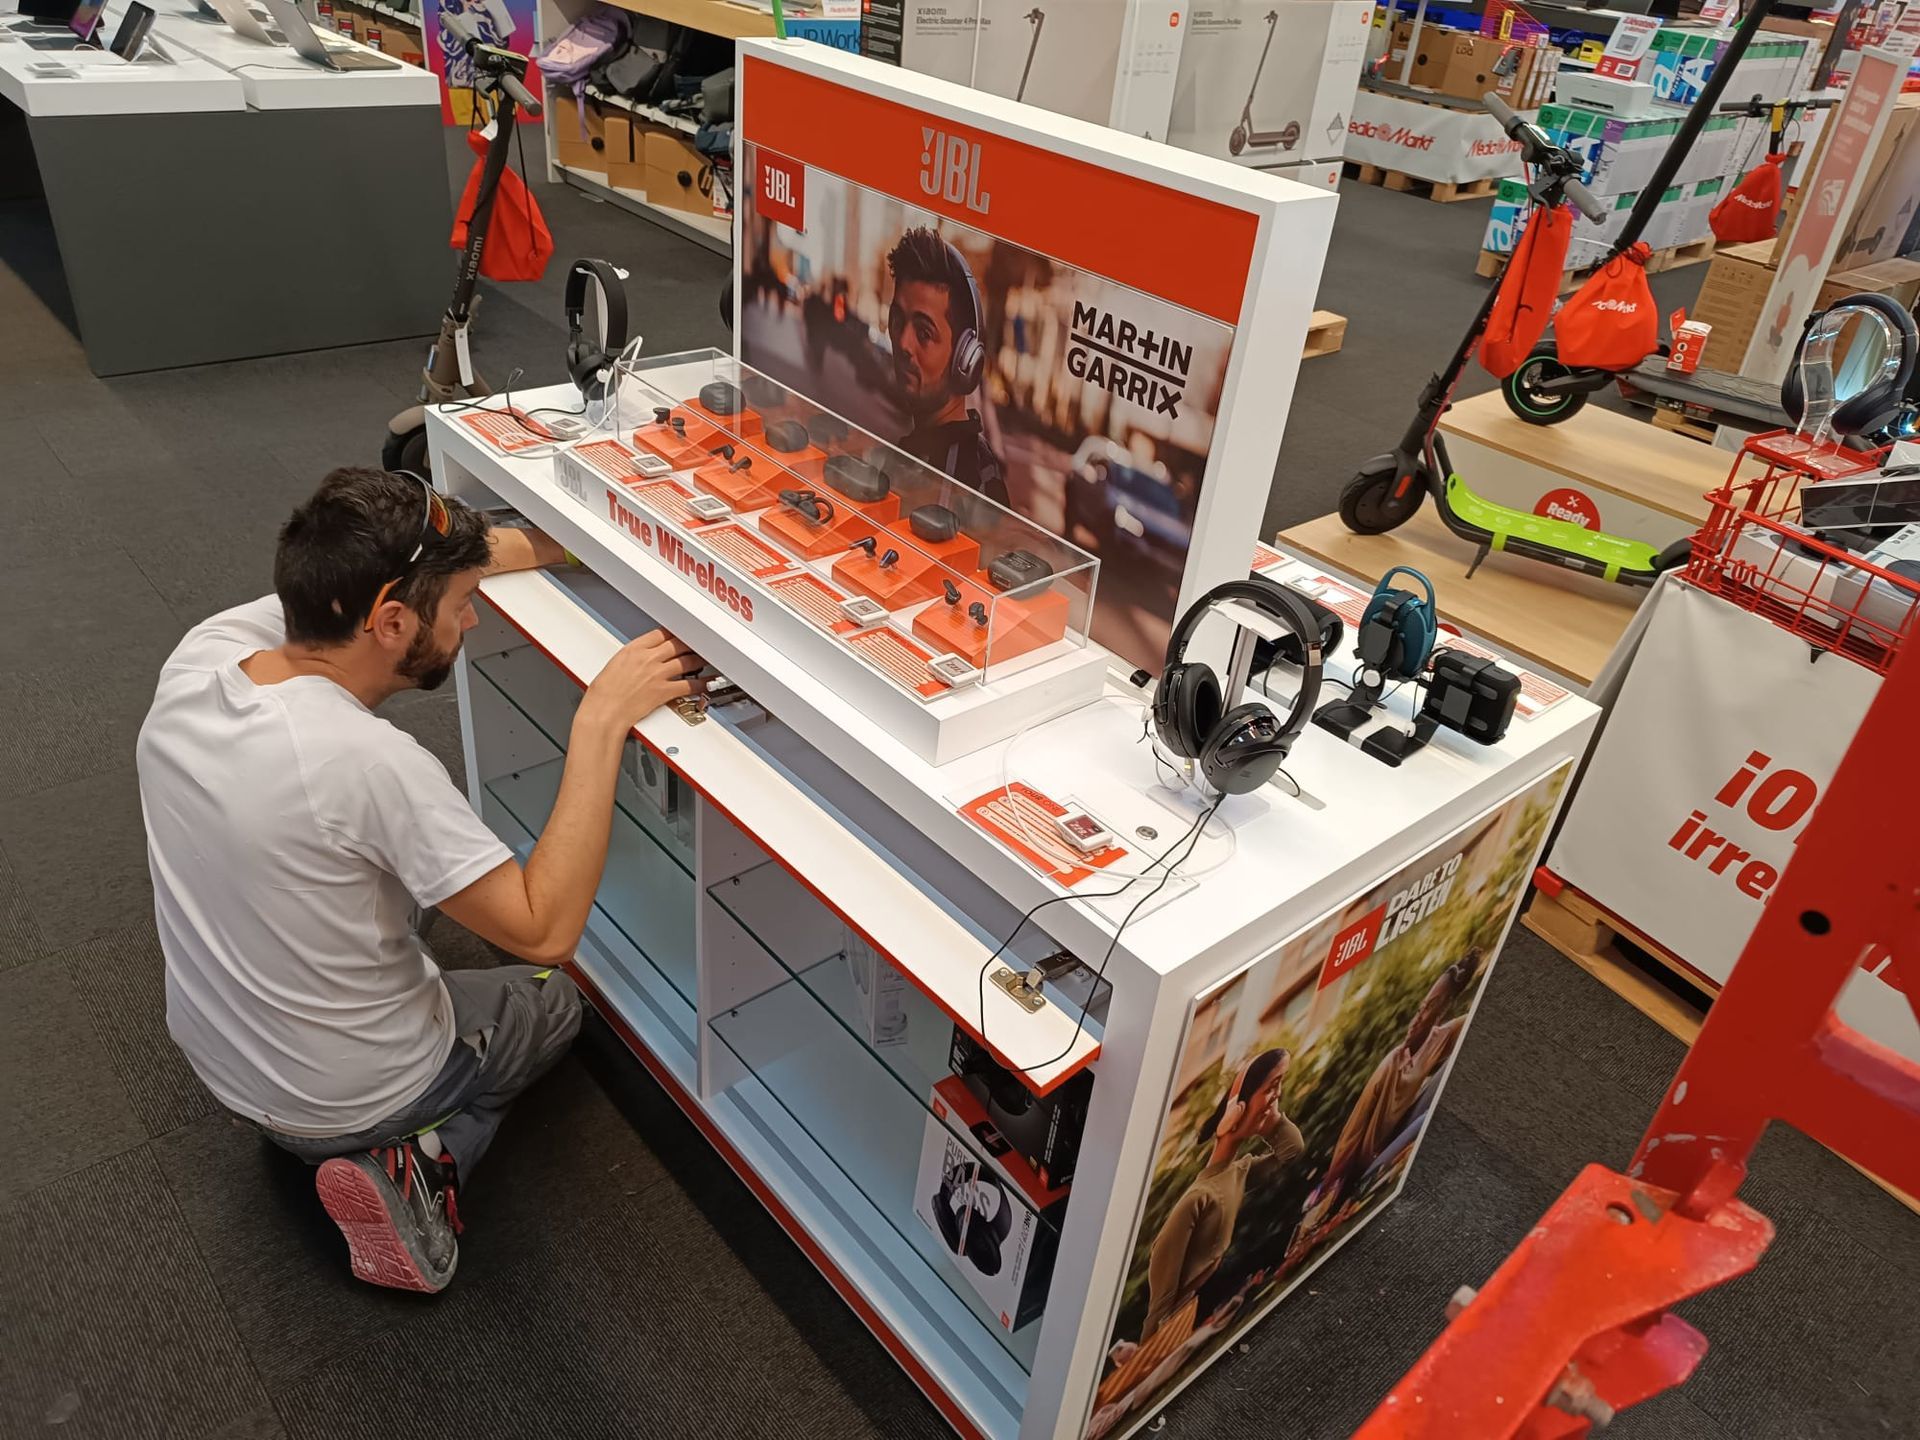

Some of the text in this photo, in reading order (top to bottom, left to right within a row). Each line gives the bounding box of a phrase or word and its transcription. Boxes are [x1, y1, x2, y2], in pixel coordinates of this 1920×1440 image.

[1349, 117, 1378, 140] edia
[764, 164, 796, 208] JBL
[919, 125, 991, 215] JBL
[1067, 346, 1183, 420] GARRIX
[559, 457, 588, 502] JBL
[1546, 501, 1591, 528] Ready
[606, 489, 653, 547] True
[655, 524, 754, 623] Wireless
[1385, 852, 1464, 919] DARE TO
[1667, 809, 1779, 906] irre
[1373, 873, 1457, 953] LISTEN
[1333, 927, 1368, 968] JBL
